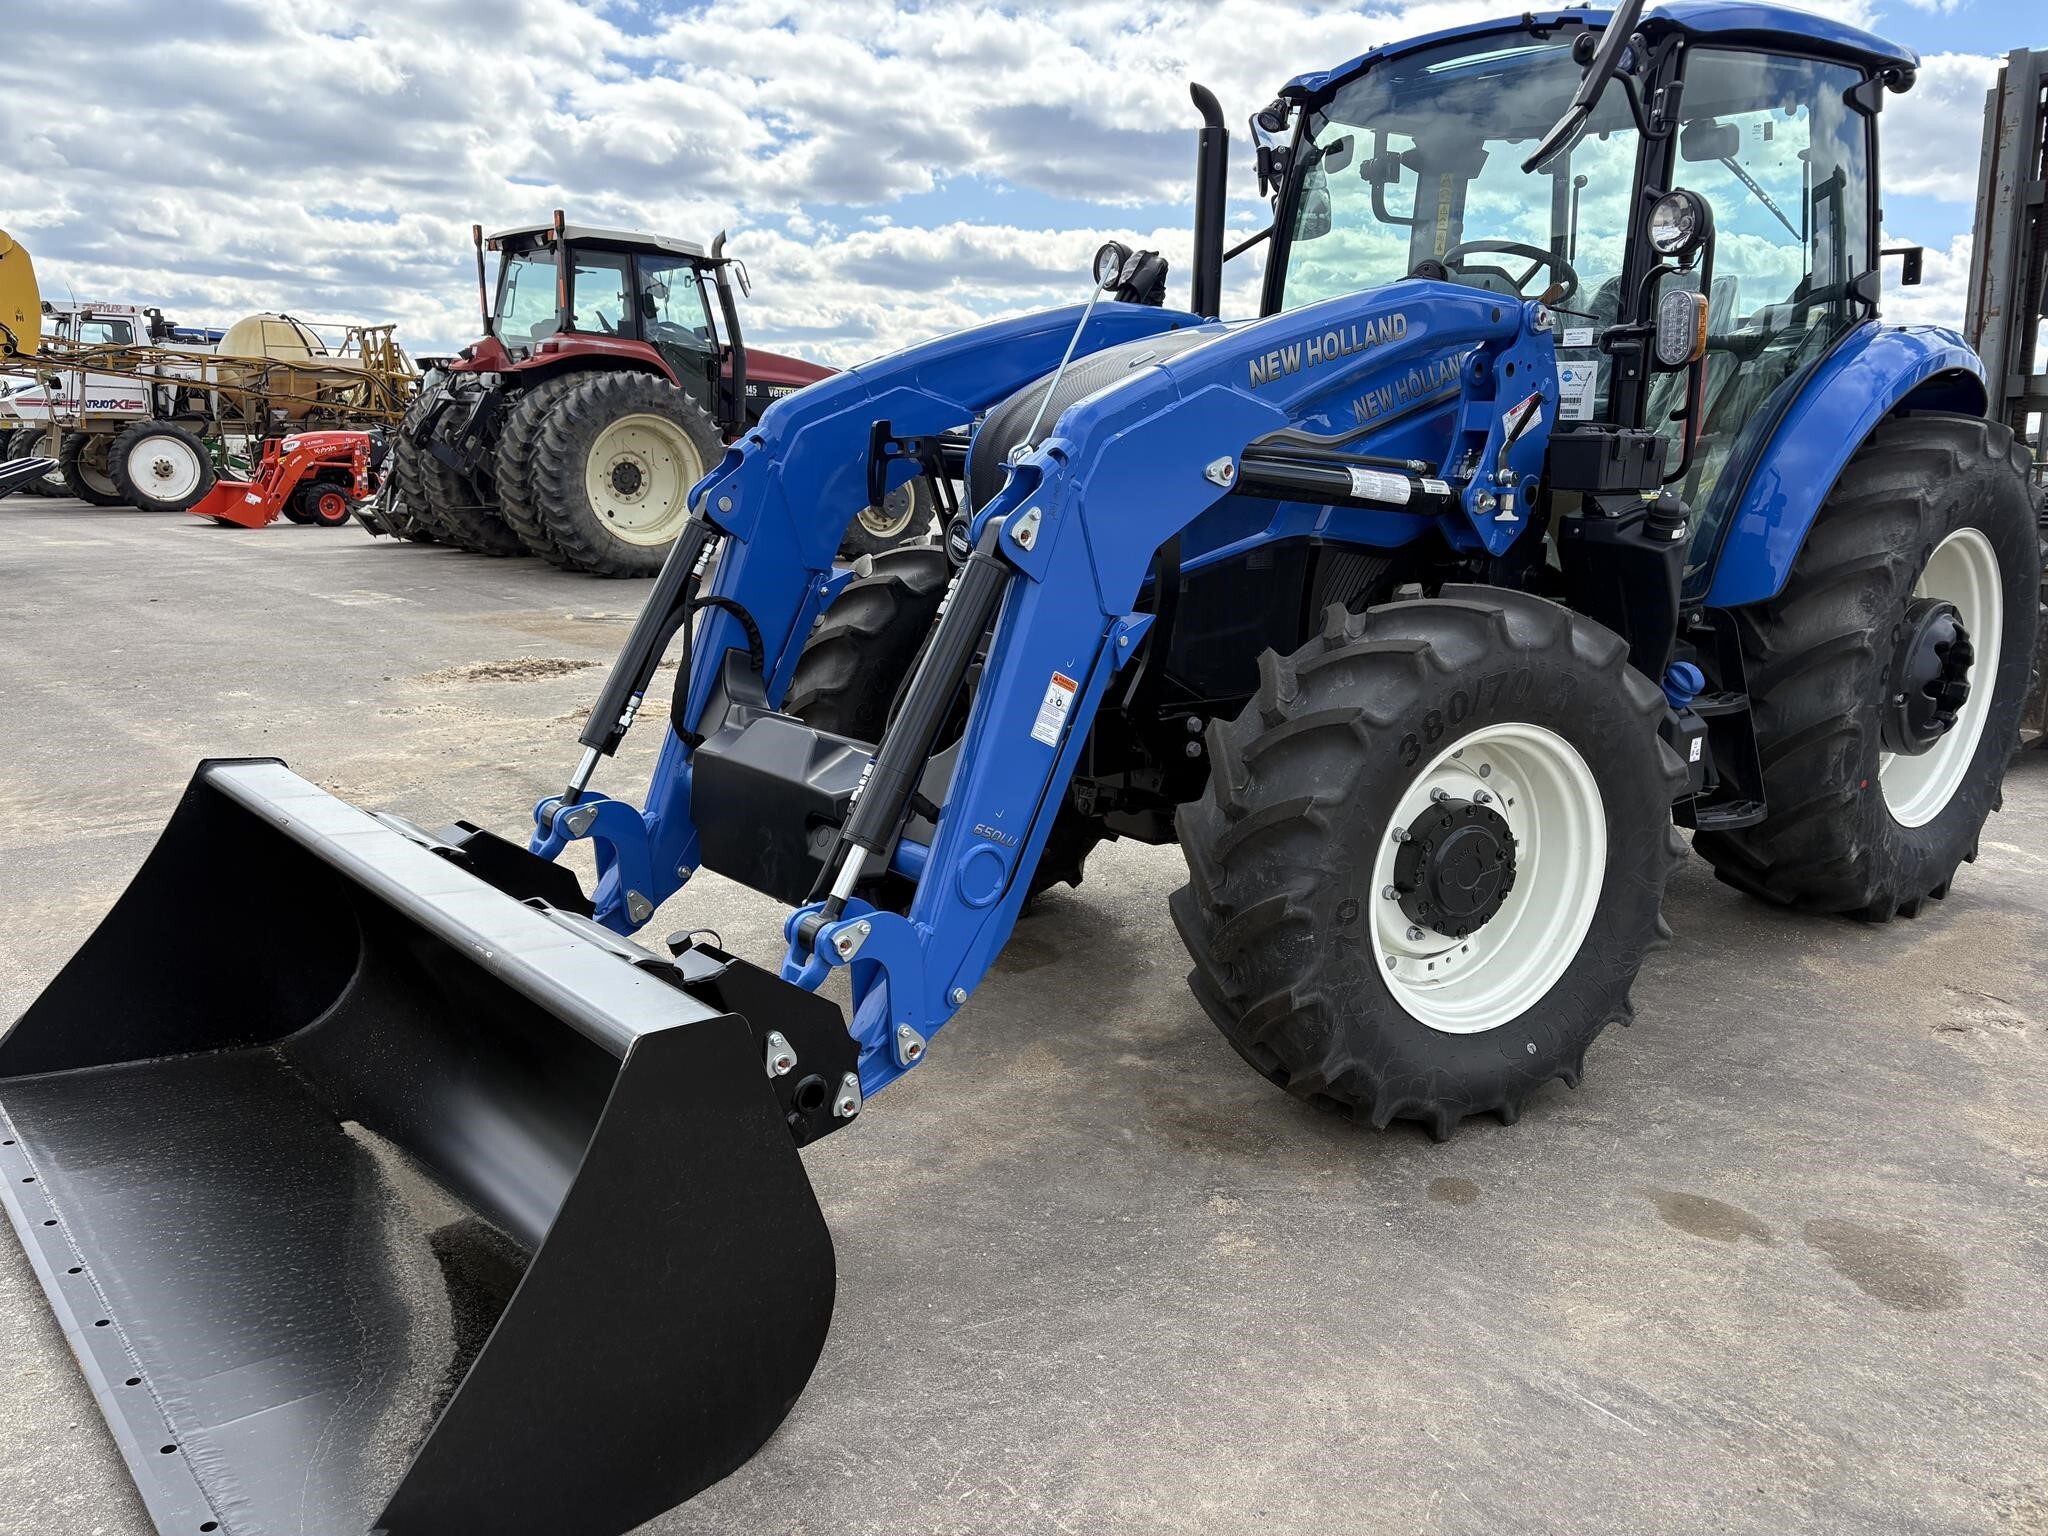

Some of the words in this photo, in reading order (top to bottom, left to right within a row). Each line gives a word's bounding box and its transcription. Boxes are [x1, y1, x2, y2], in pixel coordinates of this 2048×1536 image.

[98, 303, 122, 314] TYLER
[1249, 343, 1301, 389] NEW
[1306, 312, 1408, 367] HOLLAND
[1352, 386, 1393, 425] NEW
[973, 823, 1019, 848] 650LU
